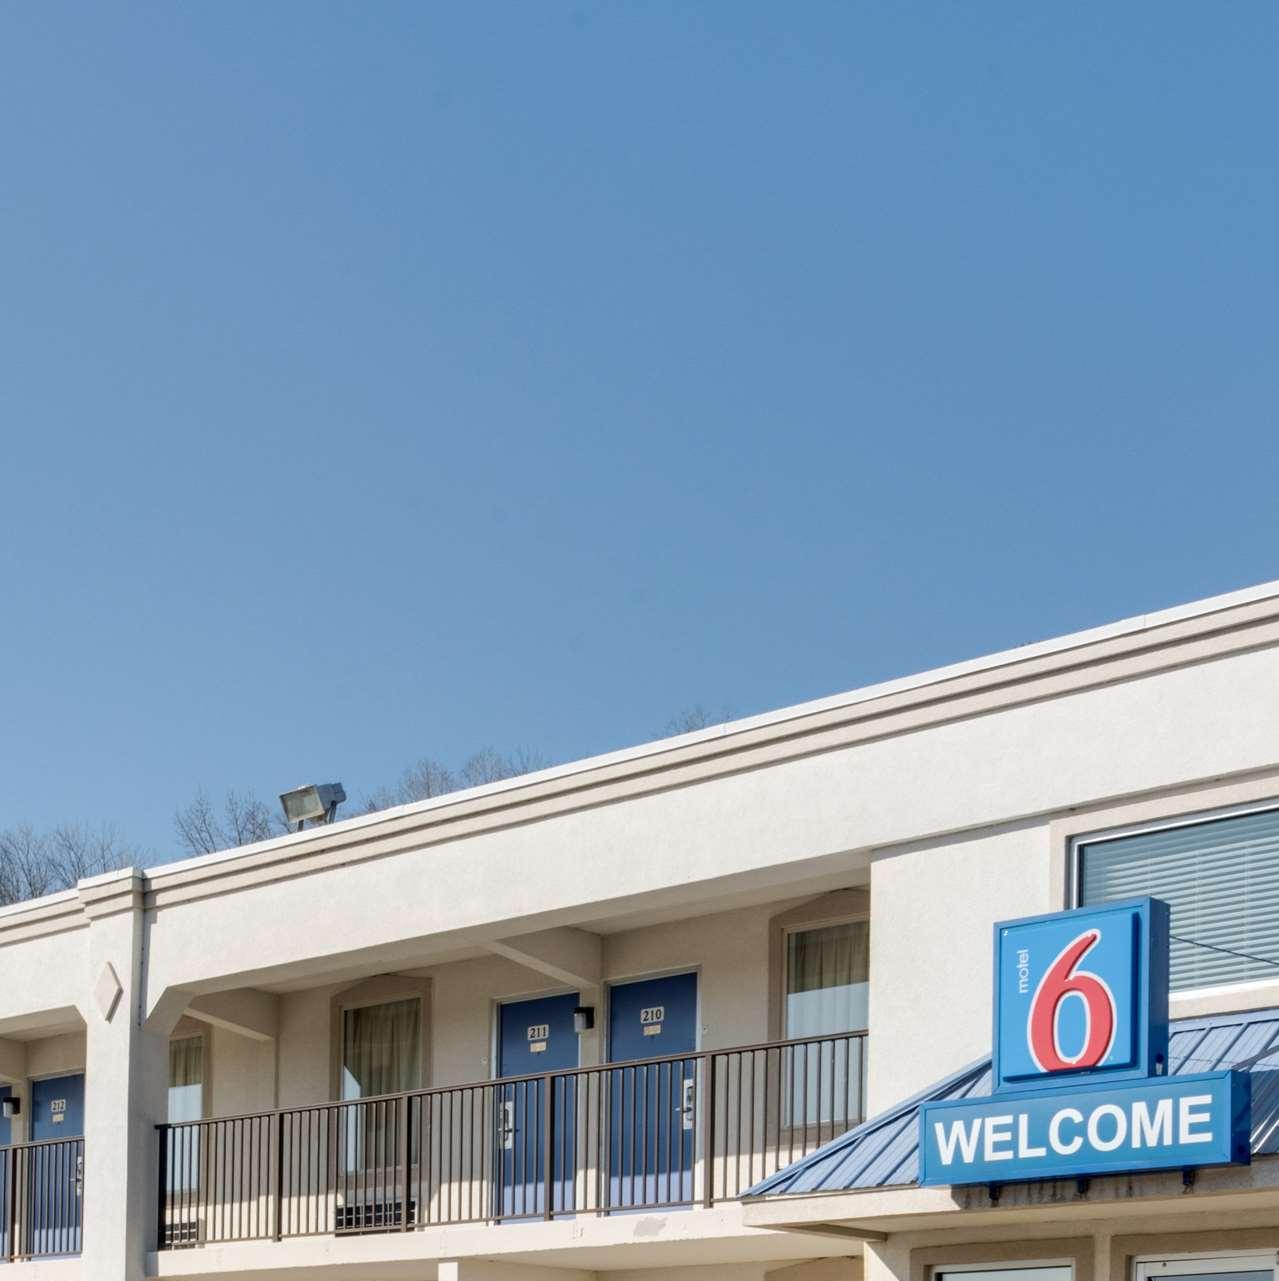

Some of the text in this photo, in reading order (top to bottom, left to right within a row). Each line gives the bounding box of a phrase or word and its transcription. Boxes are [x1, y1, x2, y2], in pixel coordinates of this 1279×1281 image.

[1016, 948, 1030, 994] motel
[642, 1009, 662, 1022] 210
[1027, 928, 1117, 1073] 6
[529, 1026, 547, 1039] 211
[934, 1094, 1213, 1165] WELCOME
